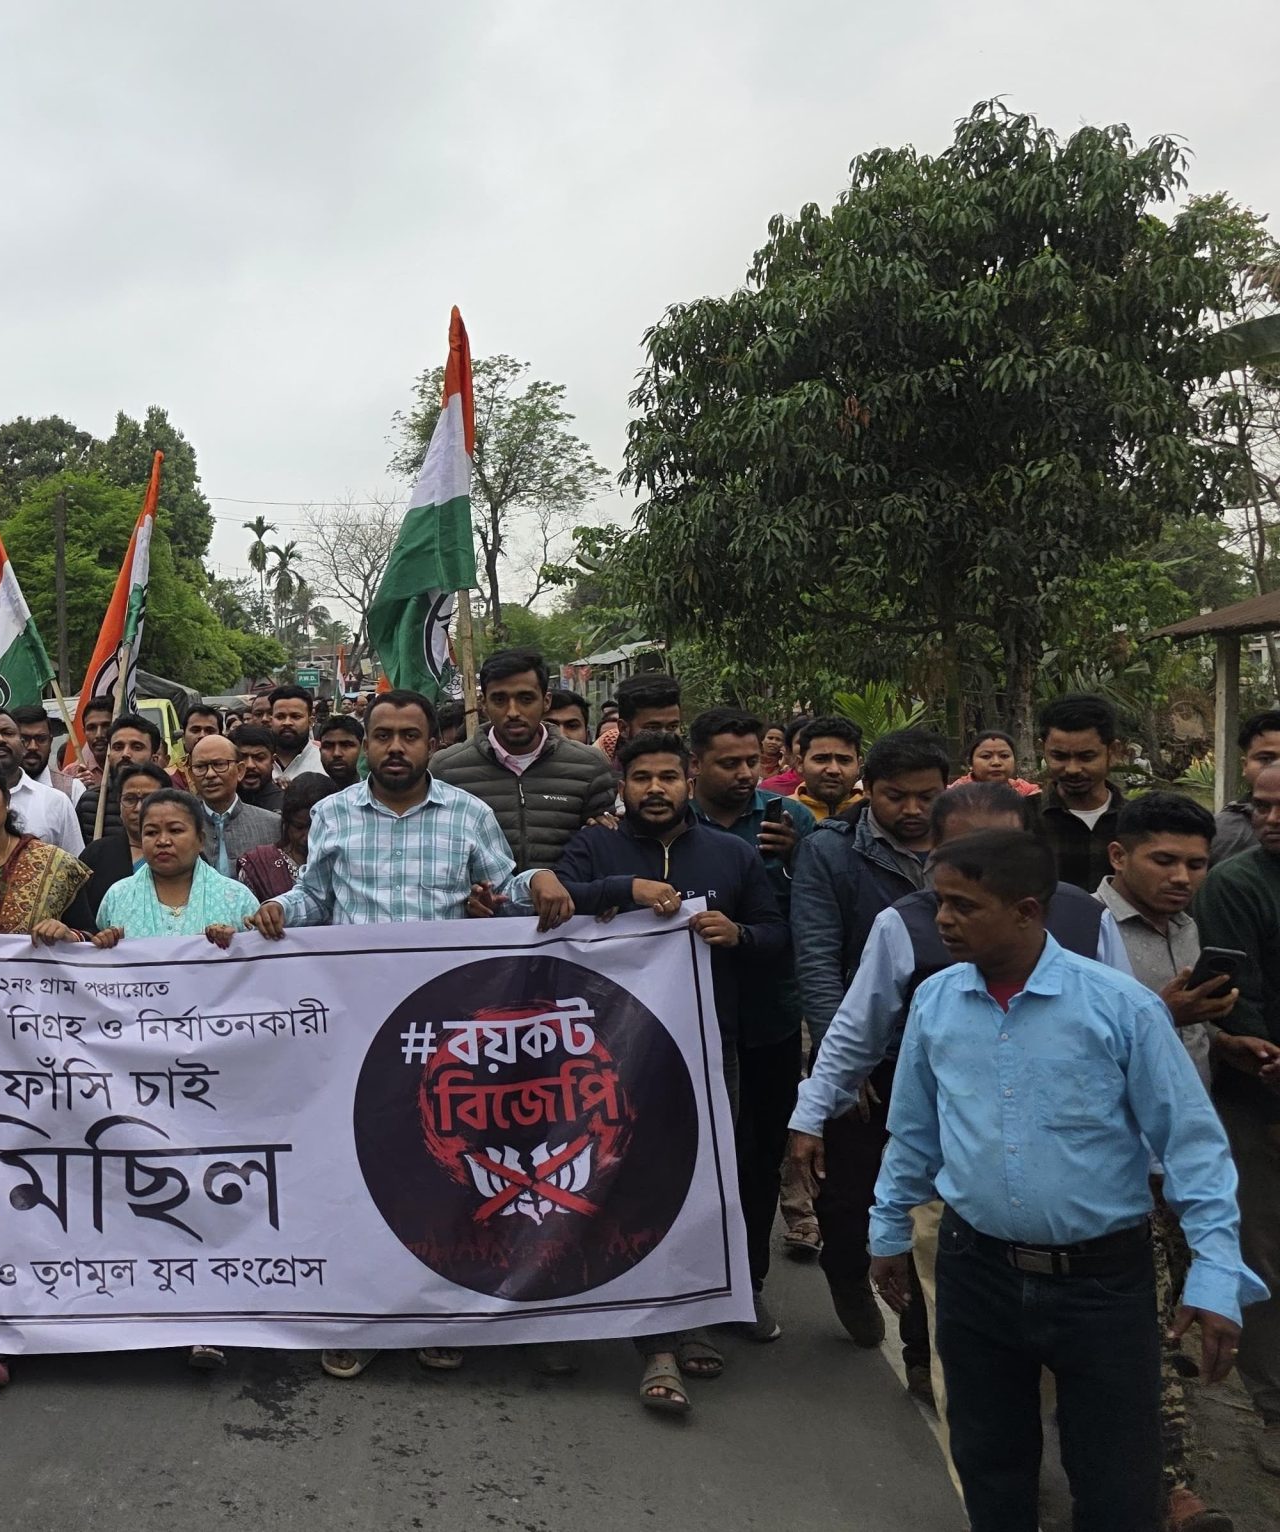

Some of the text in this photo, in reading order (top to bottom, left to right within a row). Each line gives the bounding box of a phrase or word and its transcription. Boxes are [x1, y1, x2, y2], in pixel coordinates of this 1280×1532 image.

[39, 977, 79, 996] গ্রাম
[84, 981, 171, 999] পঞ্চায়েতে
[6, 1004, 88, 1044] নিগ্রহ
[97, 1018, 124, 1038] ও
[135, 997, 330, 1042] নির্যাতনকারী
[401, 997, 595, 1073] #বয়কট
[128, 1057, 220, 1110] চাই
[433, 1059, 619, 1131] বিজেপি
[29, 1256, 138, 1300] তৃণমূল
[147, 1258, 199, 1294] যুব
[207, 1254, 328, 1288] কংগ্রেস
